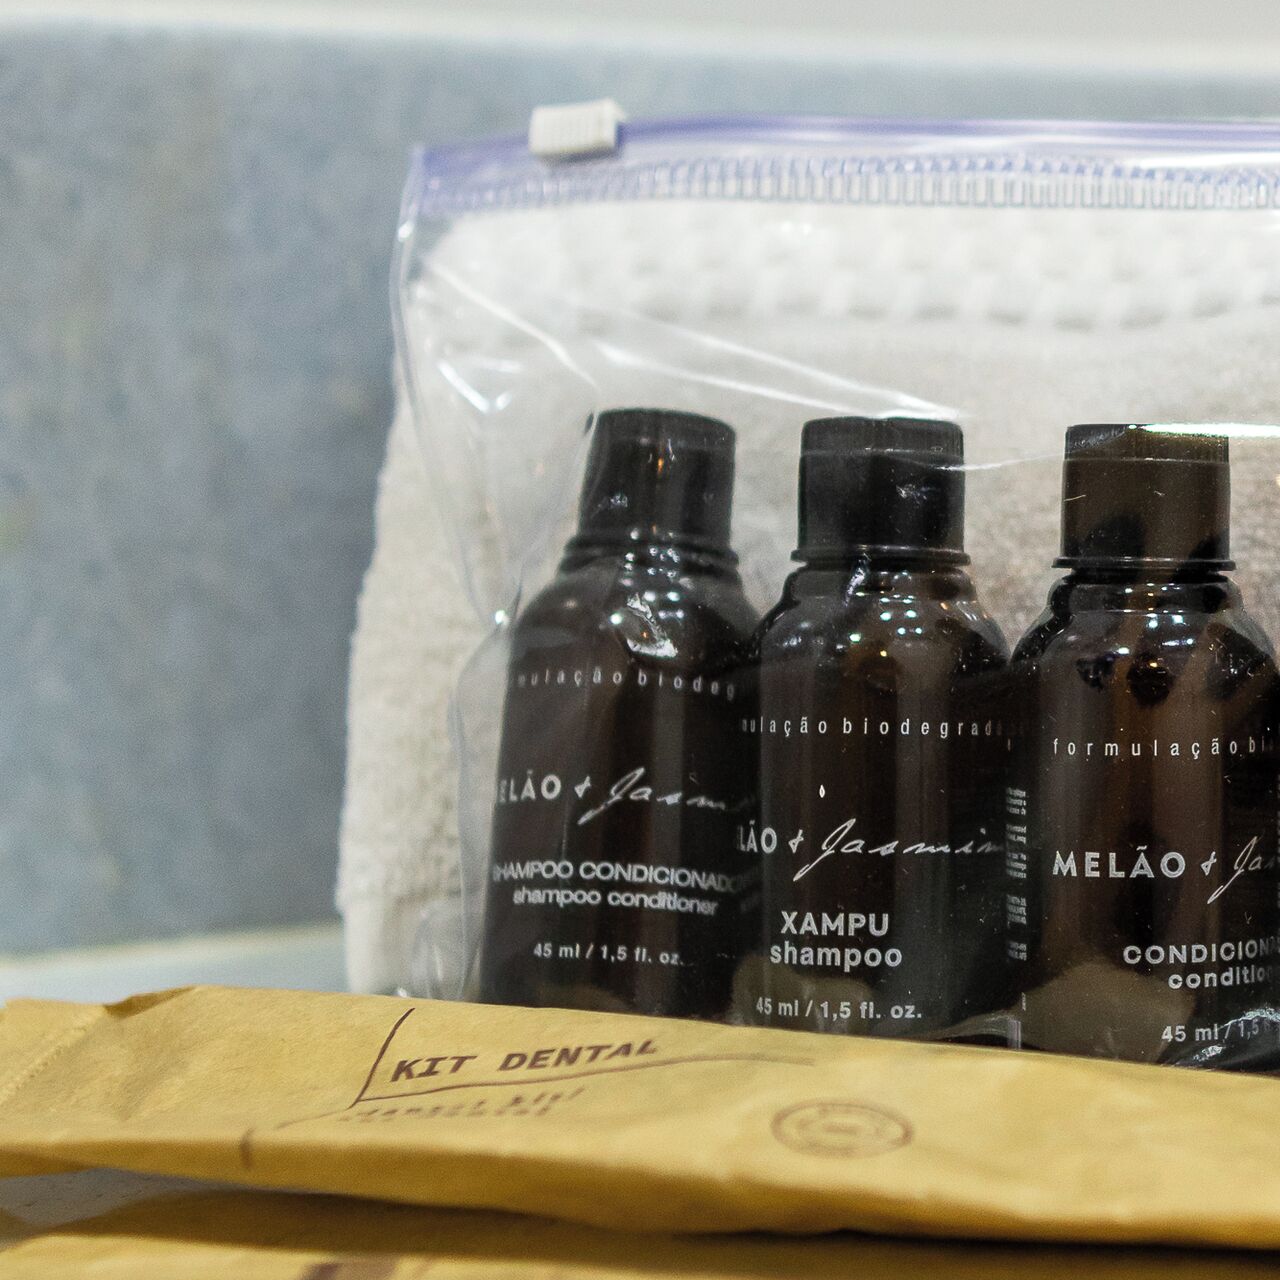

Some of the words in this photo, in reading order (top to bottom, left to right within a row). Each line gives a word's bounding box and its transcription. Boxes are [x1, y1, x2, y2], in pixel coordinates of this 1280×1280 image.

[1052, 844, 1186, 879] MELÃO
[513, 885, 601, 908] shampoo
[607, 889, 718, 916] conditioner
[780, 910, 889, 938] XAMPU
[534, 943, 551, 958] 45
[559, 943, 580, 959] ml
[600, 945, 627, 963] 1,5
[769, 940, 903, 973] shampoo
[1168, 964, 1272, 990] conditio
[756, 996, 772, 1016] 45
[777, 999, 799, 1017] ml
[805, 999, 814, 1018] /
[820, 1001, 851, 1022] 1,5
[859, 1001, 881, 1019] fl.
[890, 1003, 922, 1020] oz.
[1161, 1025, 1186, 1043] 45
[1195, 1023, 1219, 1041] ml
[390, 1054, 478, 1083] KIT
[496, 1039, 658, 1072] DENTAL
